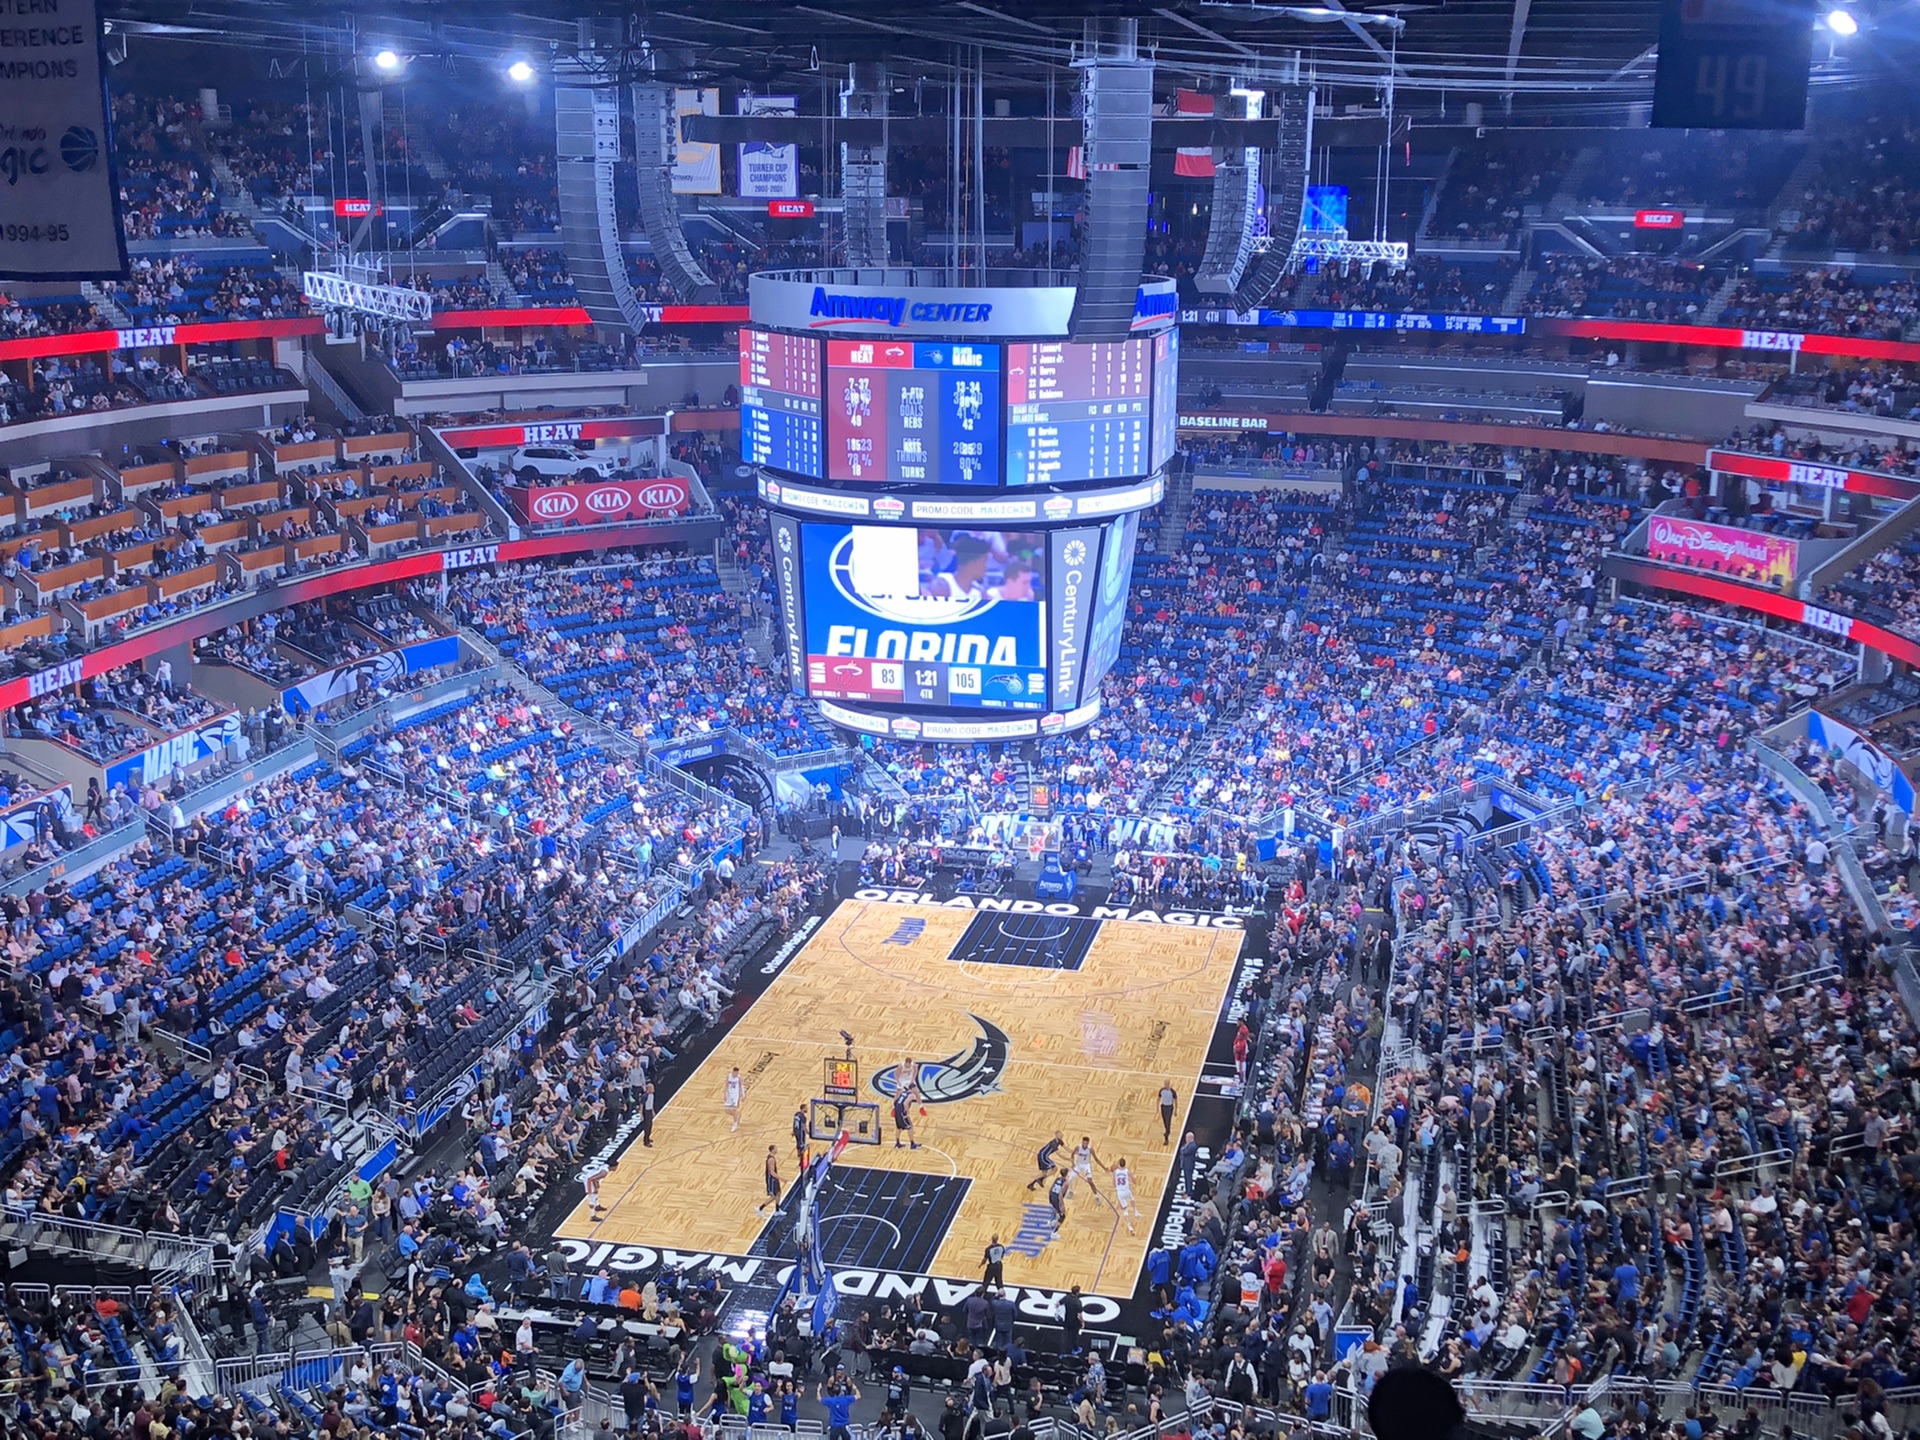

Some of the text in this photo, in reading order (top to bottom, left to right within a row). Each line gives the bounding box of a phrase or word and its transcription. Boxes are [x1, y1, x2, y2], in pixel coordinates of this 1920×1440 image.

[1697, 56, 1767, 117] 49
[749, 164, 788, 172] TURNER CUP
[750, 173, 787, 183] CHAMPIONS
[345, 203, 372, 212] HEAT
[778, 205, 805, 213] HEAT
[1644, 215, 1674, 223] HEAT
[809, 286, 993, 327] Amway CENTER
[1182, 310, 1198, 322] 1:21
[1206, 311, 1219, 323] 4TH
[1348, 314, 1353, 326] 1
[1378, 315, 1385, 327] 2
[118, 326, 176, 349] HEAT
[1743, 331, 1805, 351] HEAT
[851, 351, 874, 364] HEAT
[952, 354, 983, 367] MAGIC
[848, 377, 980, 393] 7-37 13-34
[900, 405, 923, 417] GOALS
[903, 417, 923, 429] REBS
[962, 419, 973, 430] 42
[1180, 416, 1268, 428] BASELINE BAR
[524, 424, 582, 442] HEAT
[901, 466, 925, 479] TURNS
[1790, 463, 1848, 489] HEAT
[593, 493, 624, 508] KIA
[646, 490, 677, 504] KIA
[823, 498, 865, 510] MAGICWIN
[541, 498, 571, 513] KIA
[916, 506, 1032, 515] PROMO CODE MAGICWIN
[1654, 522, 1768, 562] Walt Disney World
[442, 545, 499, 569] HEAT
[782, 559, 801, 685] CenturyLink
[1803, 604, 1854, 636] HEAT
[1057, 569, 1083, 695] CenturyLink
[826, 625, 1018, 666] FLORIDA
[28, 658, 84, 698] HEAT
[810, 662, 1045, 695] MIA 83 1:21 105 ORL
[926, 726, 957, 735] PROMO
[958, 727, 982, 735] CODE
[987, 723, 1034, 734] MAGICWIN
[143, 730, 200, 786] MAGIC
[684, 745, 713, 759] FLORIDA
[1039, 880, 1064, 890] Amway
[853, 888, 1244, 929] ORLANDO MAGIC
[1116, 1177, 1126, 1186] 55
[541, 1239, 763, 1284] MAGIC
